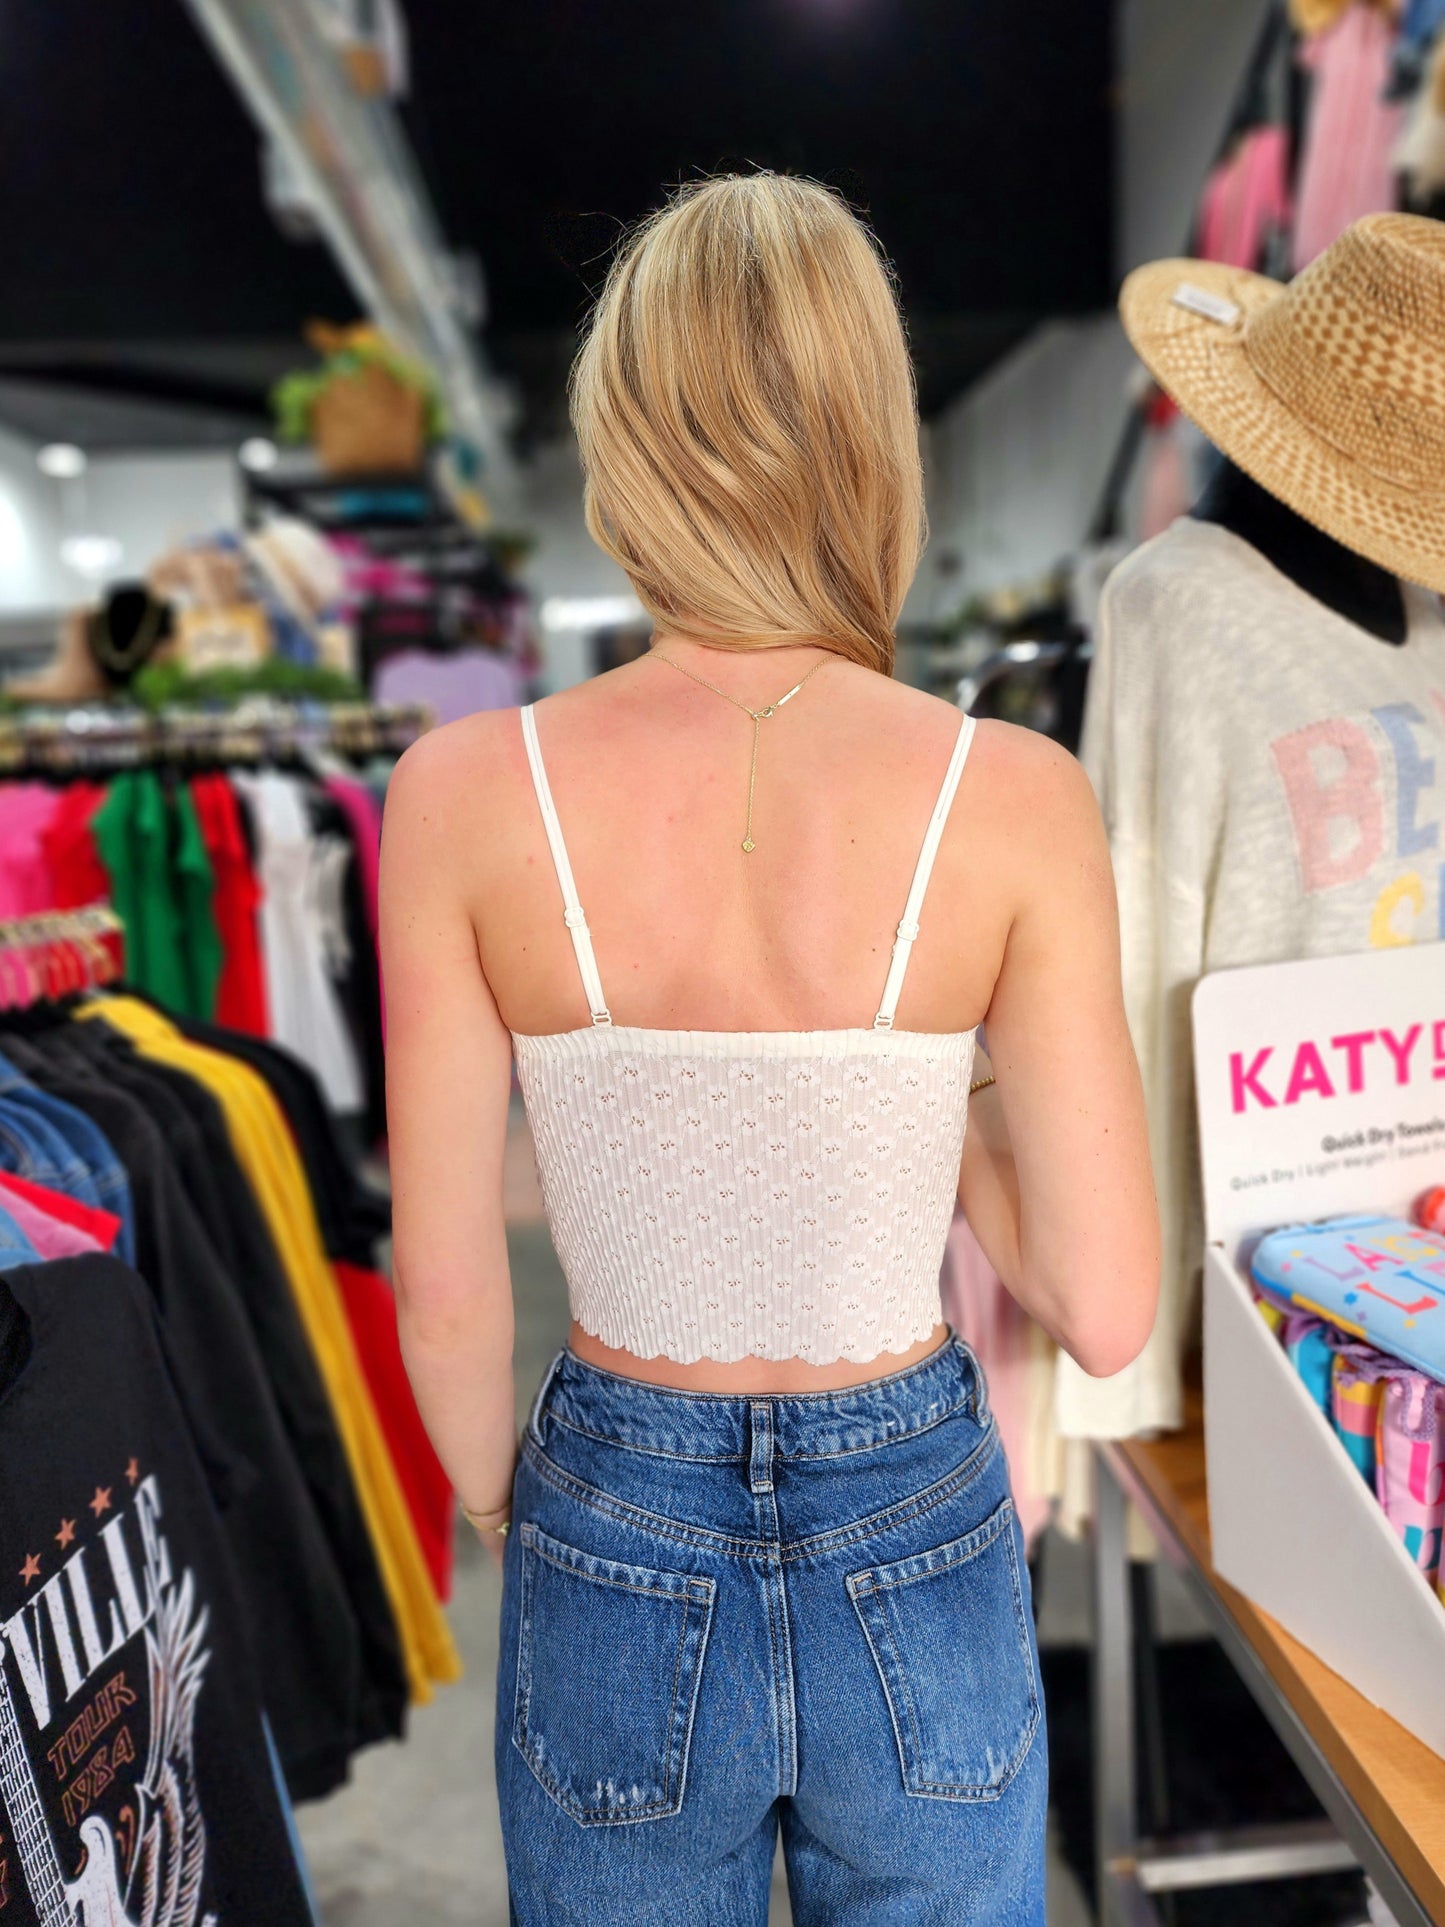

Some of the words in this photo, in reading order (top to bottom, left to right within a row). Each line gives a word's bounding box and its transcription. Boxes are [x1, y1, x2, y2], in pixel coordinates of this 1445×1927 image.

[1320, 1129, 1365, 1154] Quick
[1367, 1126, 1395, 1145] Dry
[1230, 1172, 1269, 1191] Quick
[47, 1671, 137, 1781] TOUR
[61, 1725, 136, 1827] 1984
